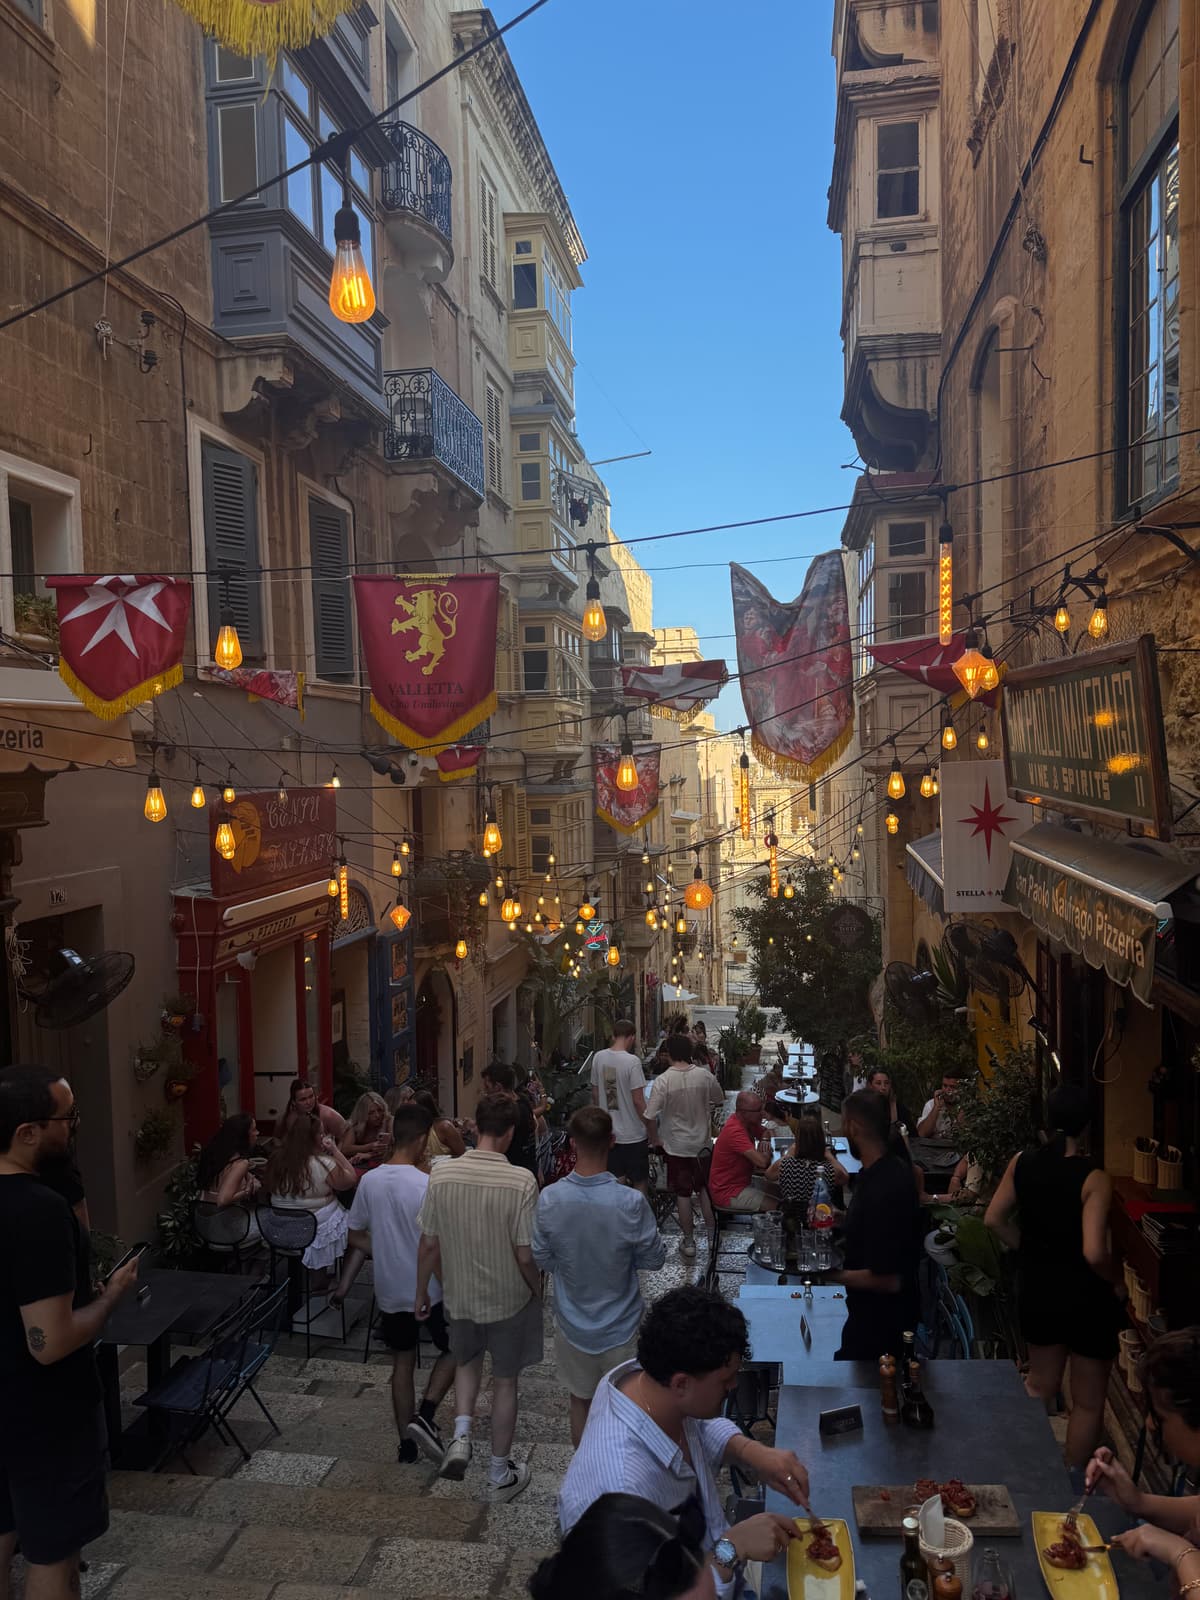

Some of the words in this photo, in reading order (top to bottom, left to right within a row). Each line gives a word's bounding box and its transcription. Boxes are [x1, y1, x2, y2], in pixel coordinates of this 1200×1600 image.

[388, 681, 465, 696] VALLETTA
[1024, 686, 1062, 757] PAOLO
[1060, 671, 1140, 762] NAUFRAGO
[1028, 762, 1049, 790] WINE
[1052, 765, 1060, 792] &
[1062, 767, 1111, 801] SPIRITS
[1027, 873, 1050, 910] Paolo
[1052, 886, 1094, 941] Naufrago
[1095, 909, 1145, 968] Pizzeria
